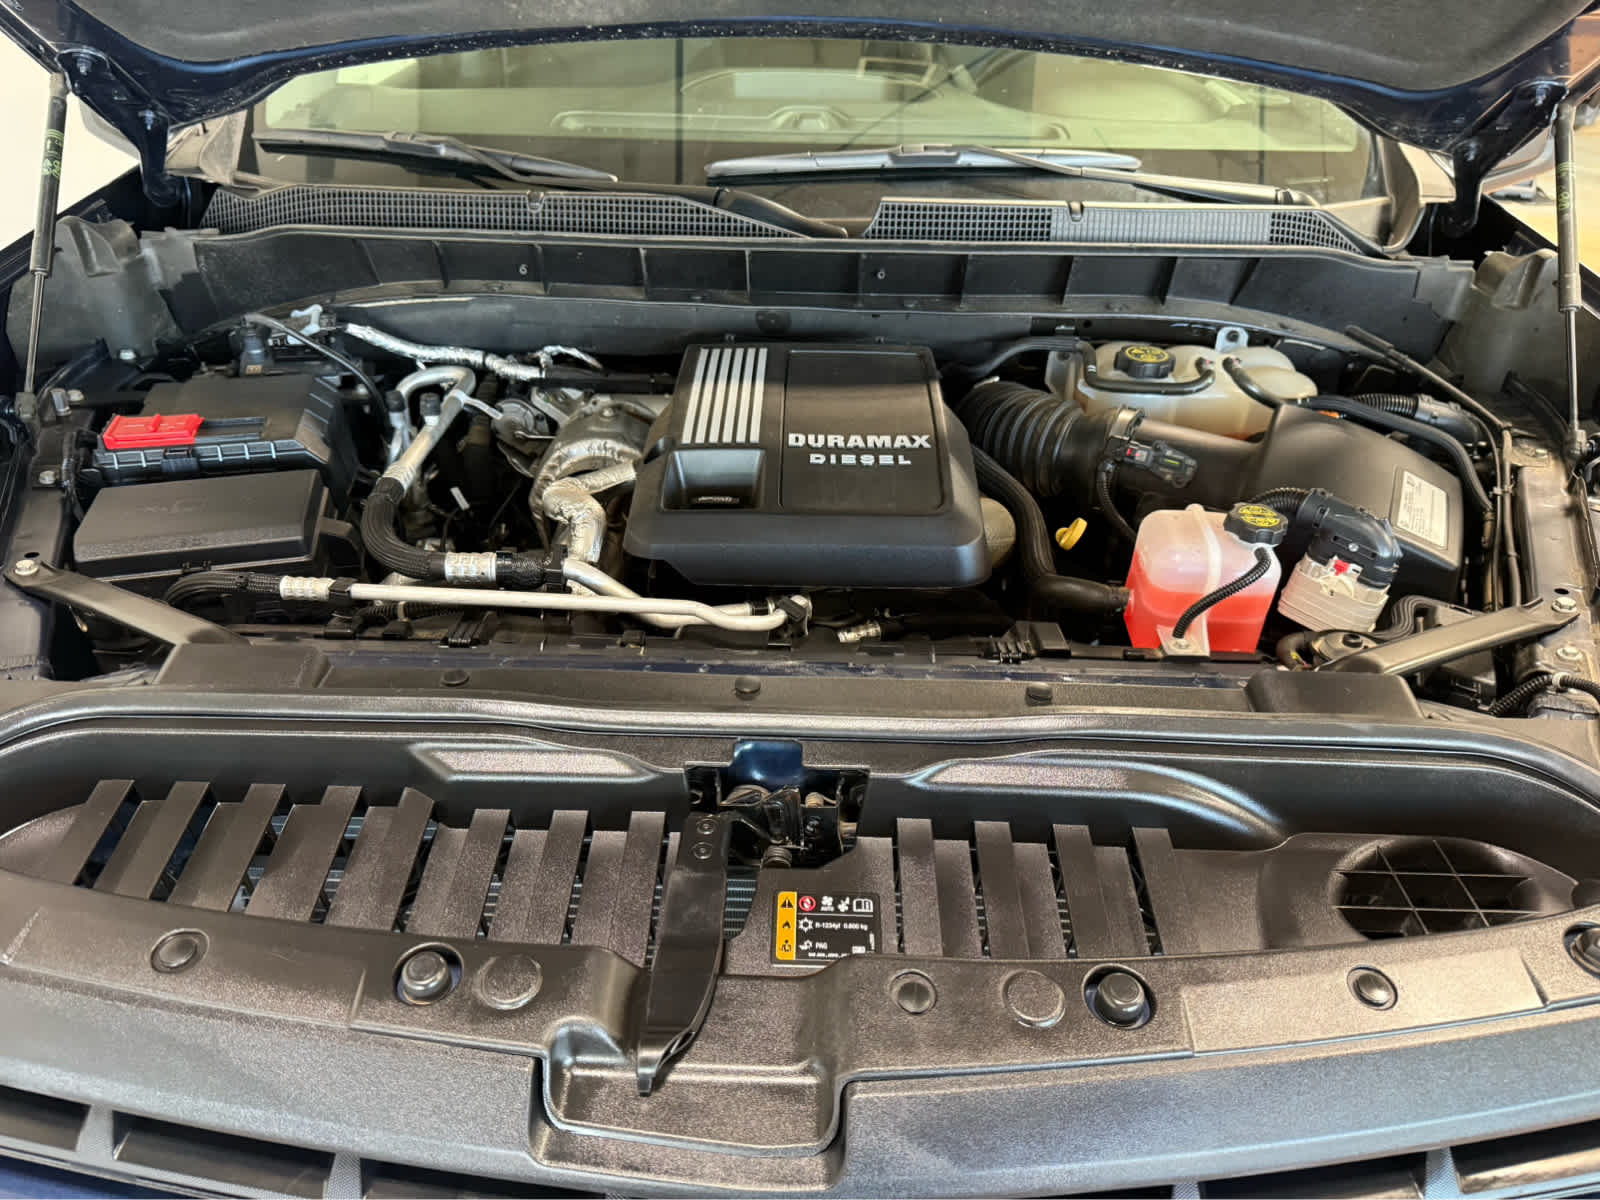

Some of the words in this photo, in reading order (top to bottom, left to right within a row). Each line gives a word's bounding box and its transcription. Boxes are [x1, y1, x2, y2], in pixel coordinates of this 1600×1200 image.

[788, 432, 931, 449] DURAMAX
[809, 454, 911, 465] DIESEL
[860, 923, 868, 931] kg
[815, 942, 828, 950] PAG
